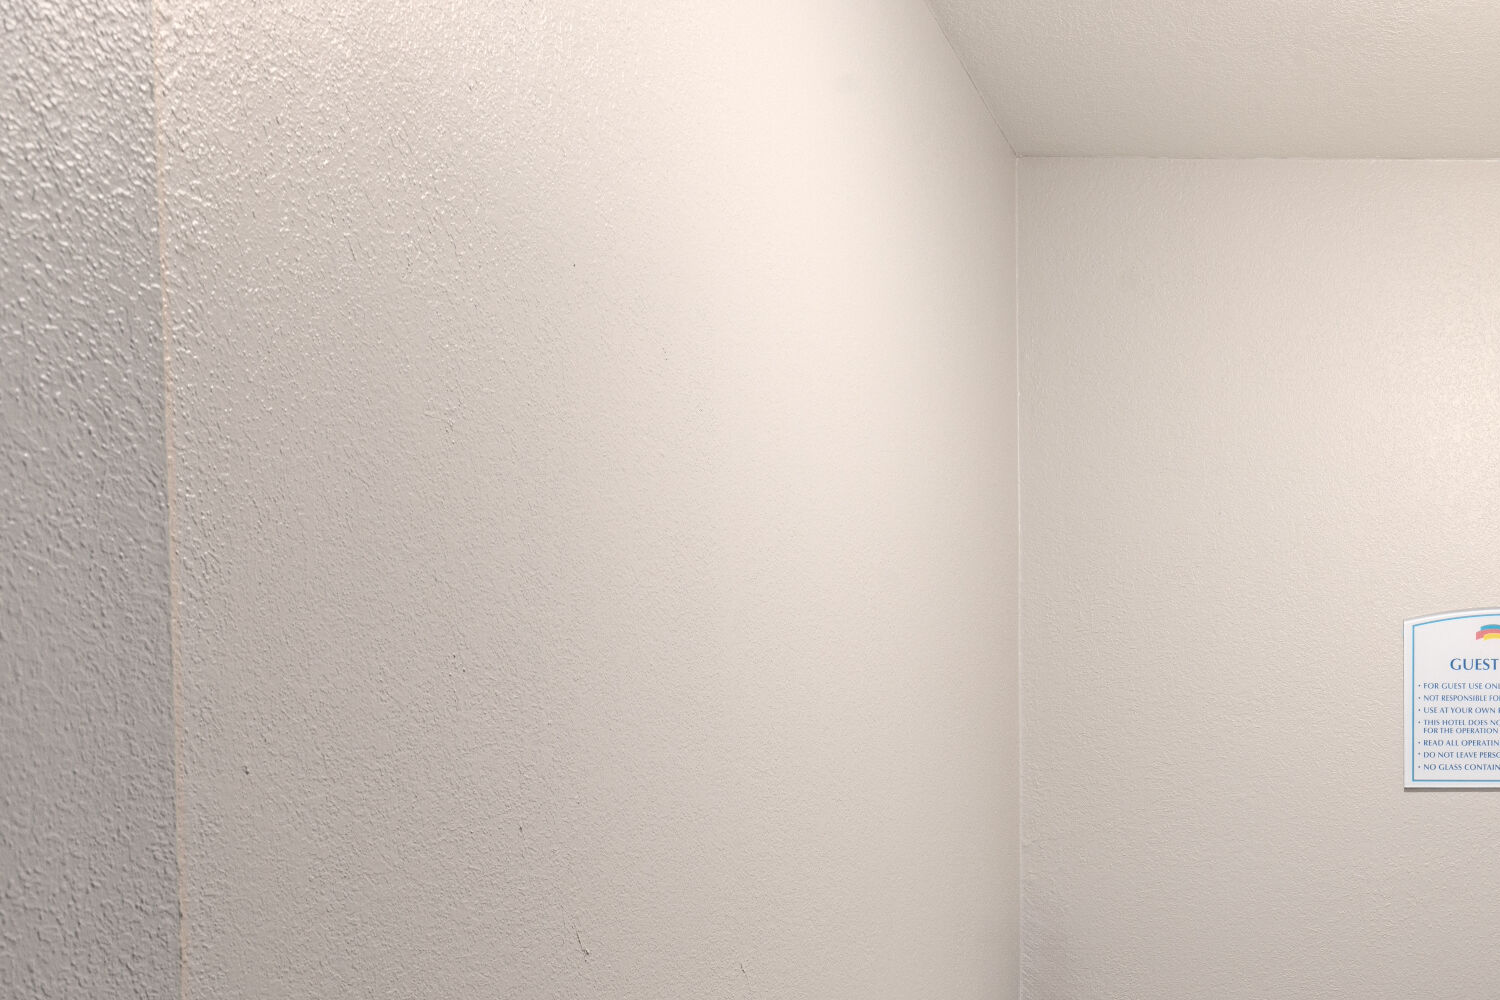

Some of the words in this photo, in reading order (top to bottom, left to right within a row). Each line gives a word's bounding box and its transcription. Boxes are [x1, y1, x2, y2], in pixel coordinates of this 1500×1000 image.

[1449, 658, 1499, 671] GUEST
[1423, 682, 1439, 690] FOR
[1441, 682, 1466, 690] GUEST
[1468, 682, 1483, 690] USE
[1423, 694, 1439, 702] NOT
[1441, 694, 1487, 702] RESPONSIBLE
[1423, 706, 1438, 714] USE
[1439, 706, 1448, 714] AT
[1450, 706, 1473, 714] YOUR
[1474, 706, 1496, 714] OWN
[1423, 739, 1444, 747] READ
[1445, 739, 1459, 747] ALL
[1423, 751, 1436, 759] DO
[1437, 751, 1454, 759] NOT
[1456, 751, 1478, 759] LEAVE
[1423, 763, 1437, 771] NO
[1438, 763, 1462, 771] GLASS
